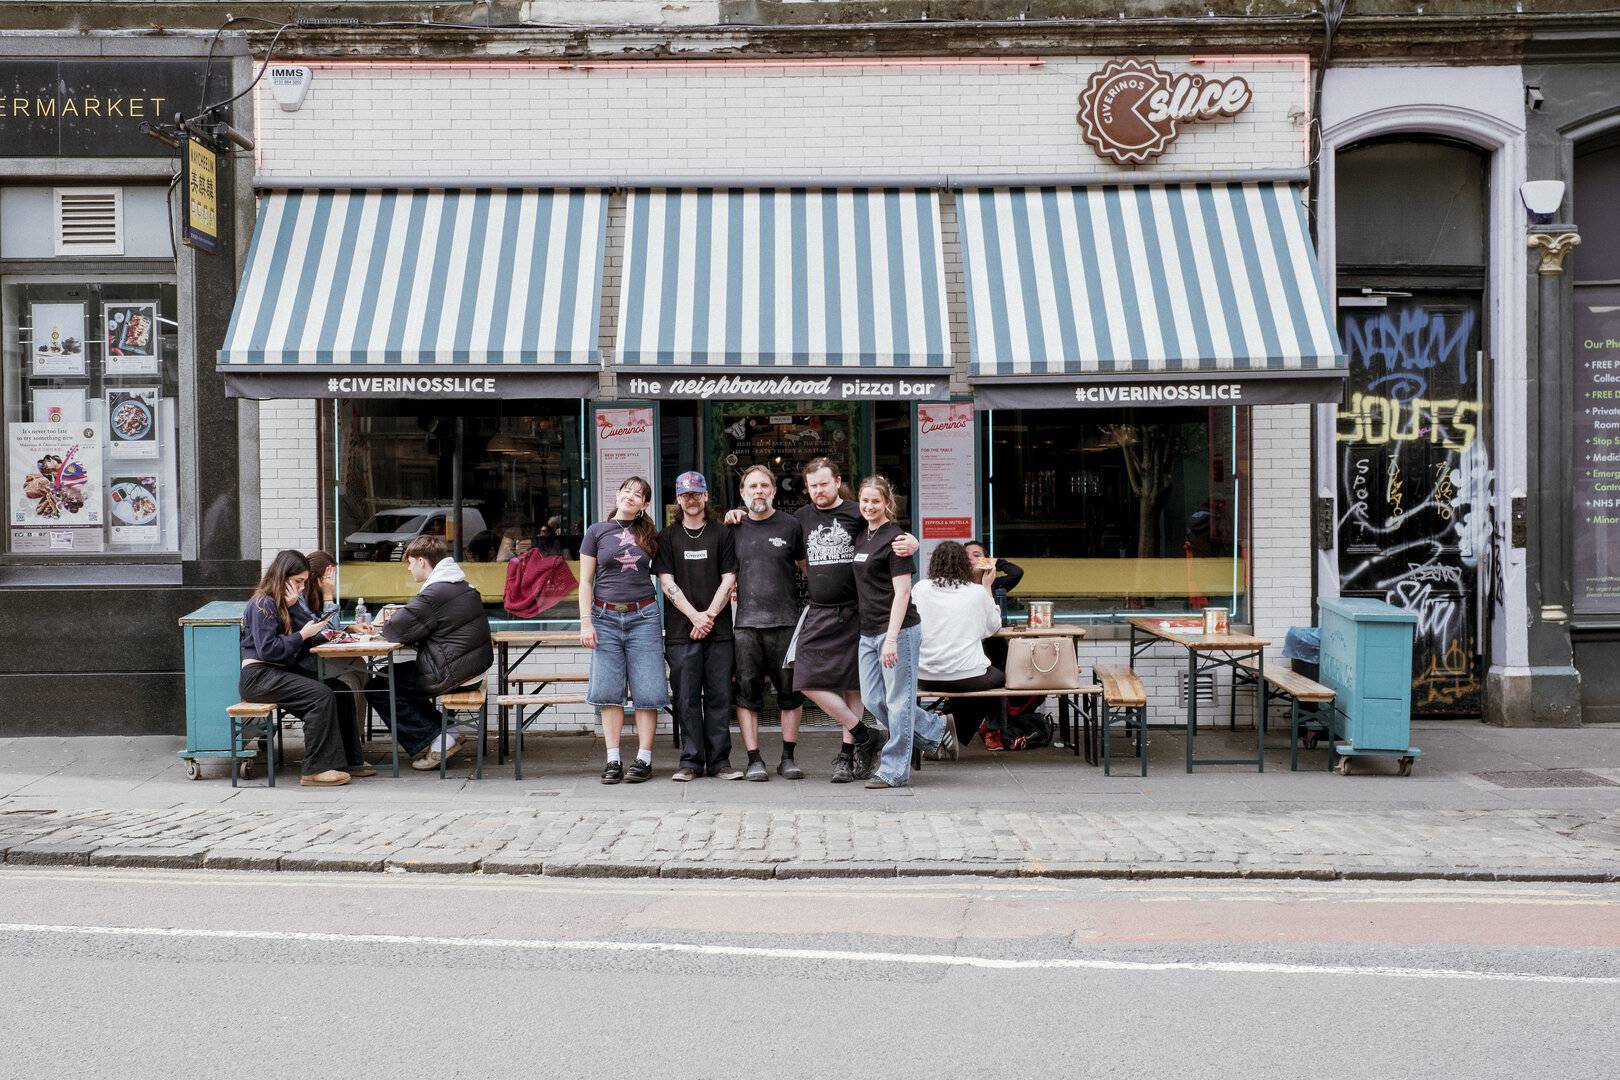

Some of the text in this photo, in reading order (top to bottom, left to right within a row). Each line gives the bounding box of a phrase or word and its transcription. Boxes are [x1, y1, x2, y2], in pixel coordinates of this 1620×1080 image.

[272, 69, 304, 77] IMMS
[1101, 78, 1146, 125] CIVERINOS
[1147, 76, 1250, 123] slice
[1584, 339, 1604, 349] Our
[1591, 361, 1612, 369] FREE
[327, 376, 496, 393] #CIVERINOSSLICE
[629, 375, 936, 398] the neighbourhood pizza bar
[1075, 384, 1242, 402] #CIVERINOSSLICE
[1592, 391, 1613, 399] FREE
[1594, 421, 1619, 429] Room
[1592, 437, 1612, 447] Stop
[1592, 499, 1614, 508] NHS
[1593, 516, 1619, 524] Minor
